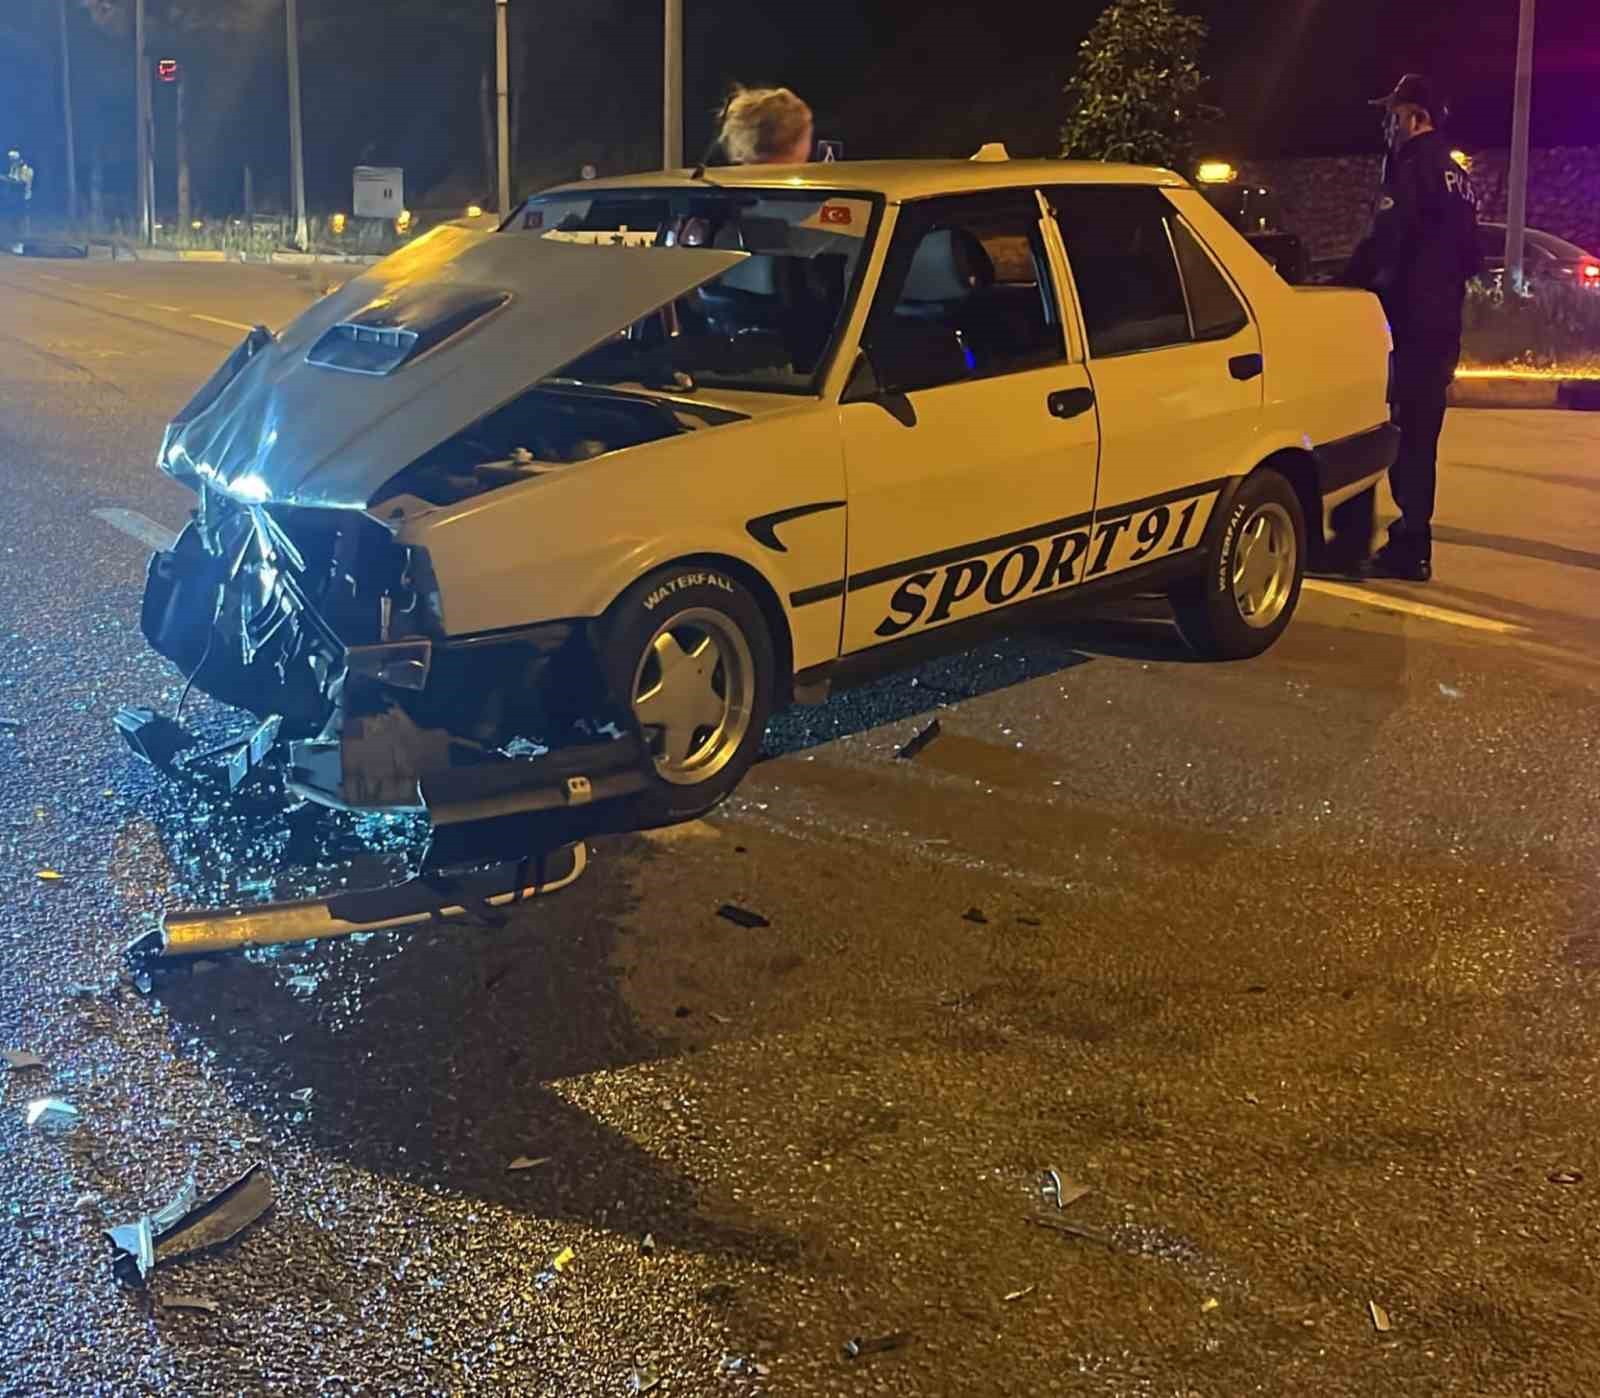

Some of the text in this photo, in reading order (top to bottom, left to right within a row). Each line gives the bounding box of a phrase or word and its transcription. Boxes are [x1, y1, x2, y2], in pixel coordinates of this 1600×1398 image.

[643, 573, 734, 610] WATERFALL
[874, 499, 1199, 636] SPORT 91
